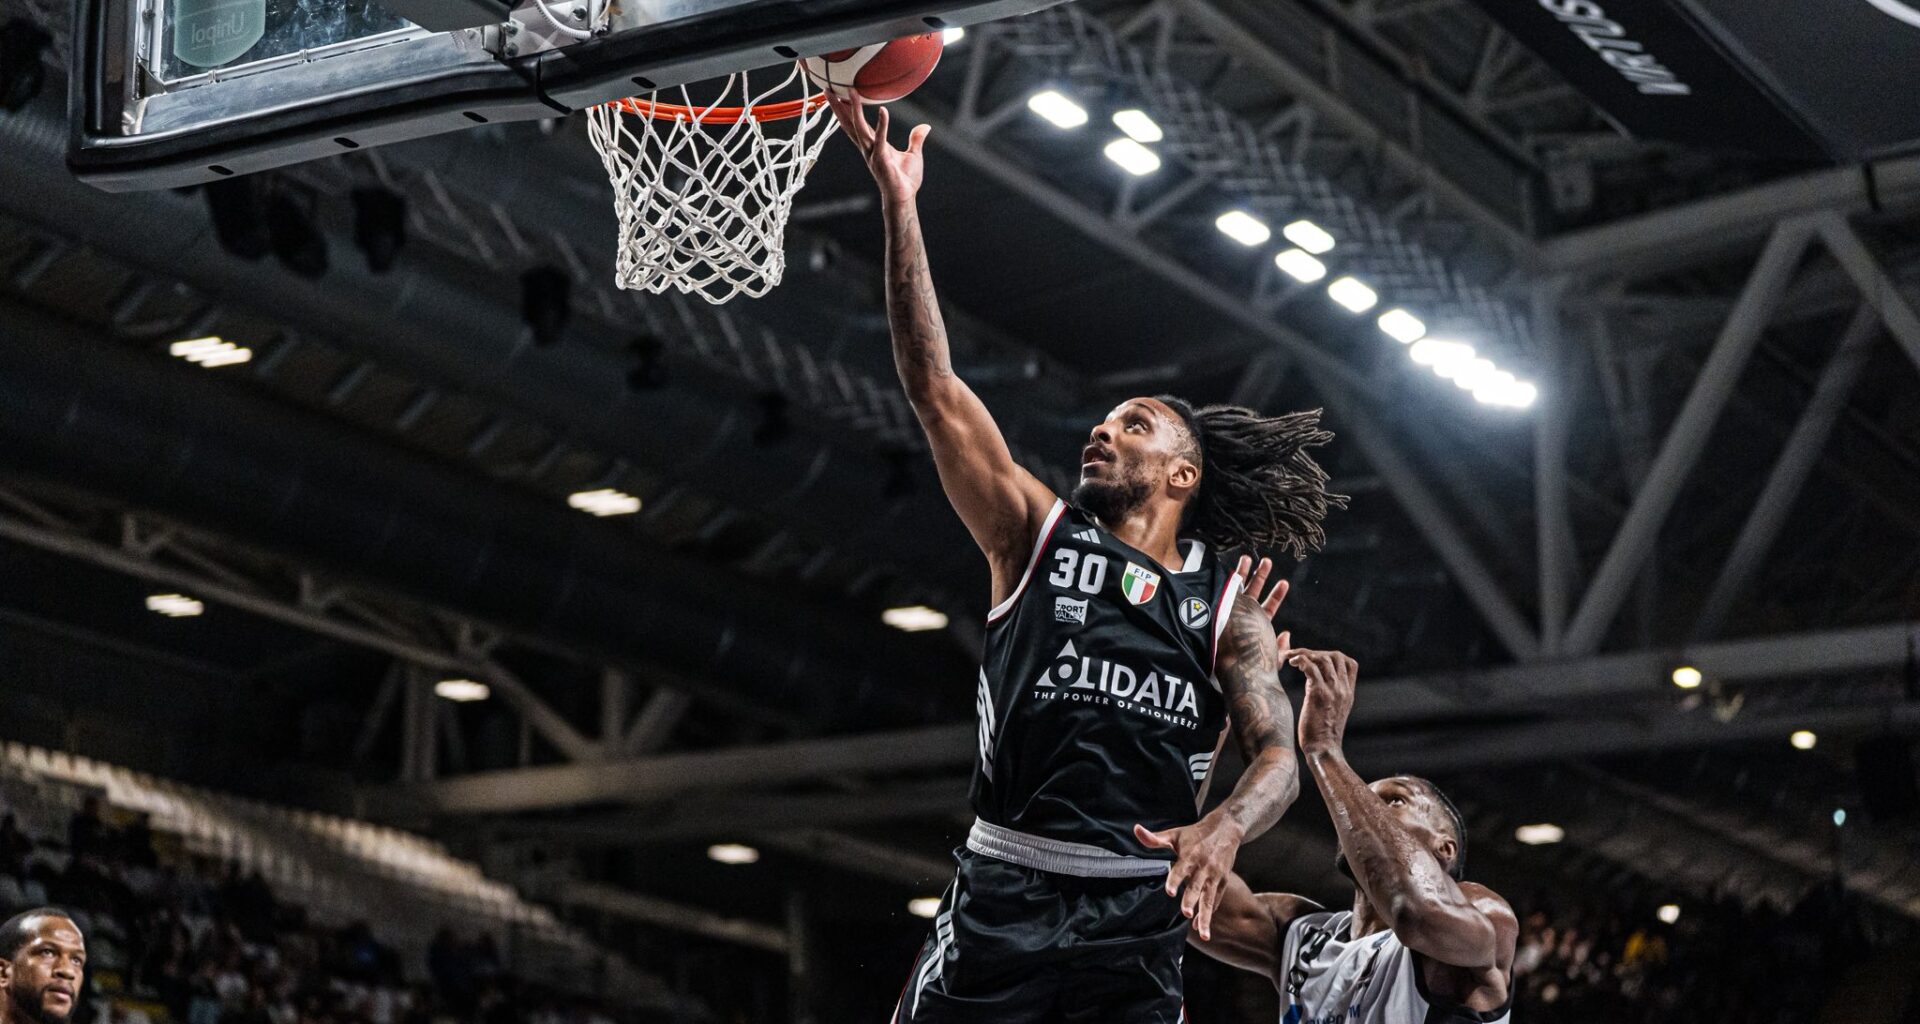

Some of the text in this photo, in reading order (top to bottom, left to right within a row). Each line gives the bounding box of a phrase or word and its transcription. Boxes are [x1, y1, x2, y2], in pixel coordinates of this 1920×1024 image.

[1049, 547, 1108, 595] 30
[1133, 567, 1152, 580] FIP
[1034, 691, 1198, 730] THE POWER OF PIONEERS
